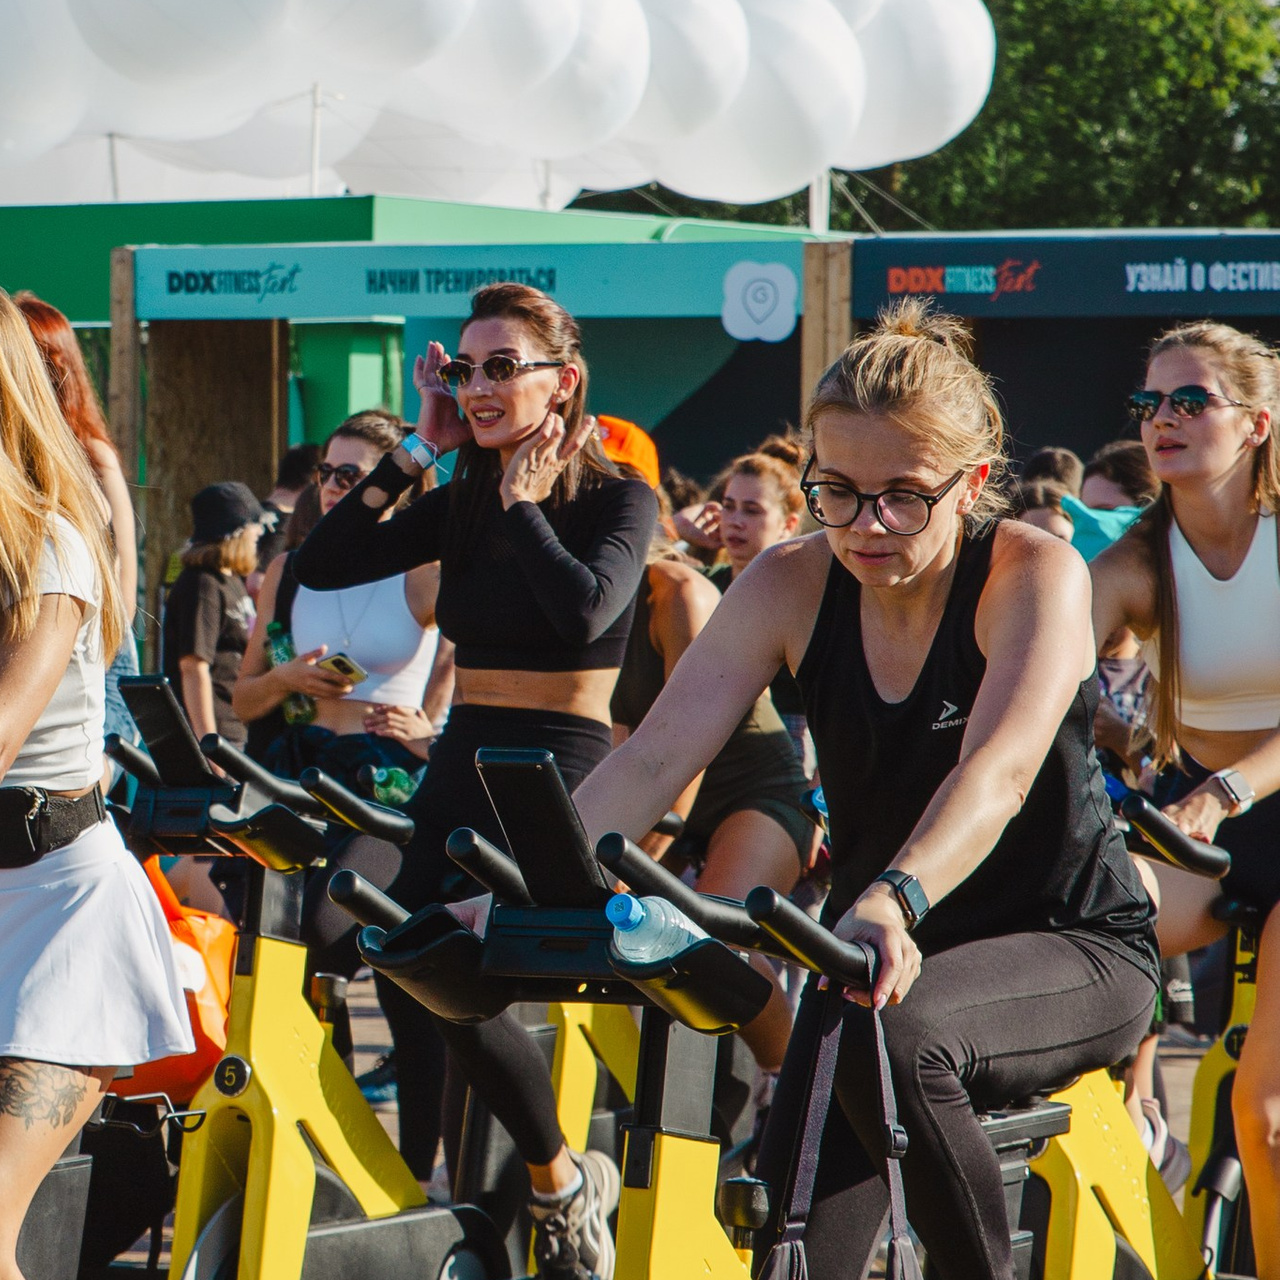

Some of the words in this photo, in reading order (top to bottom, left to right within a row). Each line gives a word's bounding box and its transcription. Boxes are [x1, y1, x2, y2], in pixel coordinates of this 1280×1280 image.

[367, 269, 419, 294] НАЧНИ
[1125, 257, 1187, 292] УЗНАЙ
[224, 1066, 236, 1087] 5
